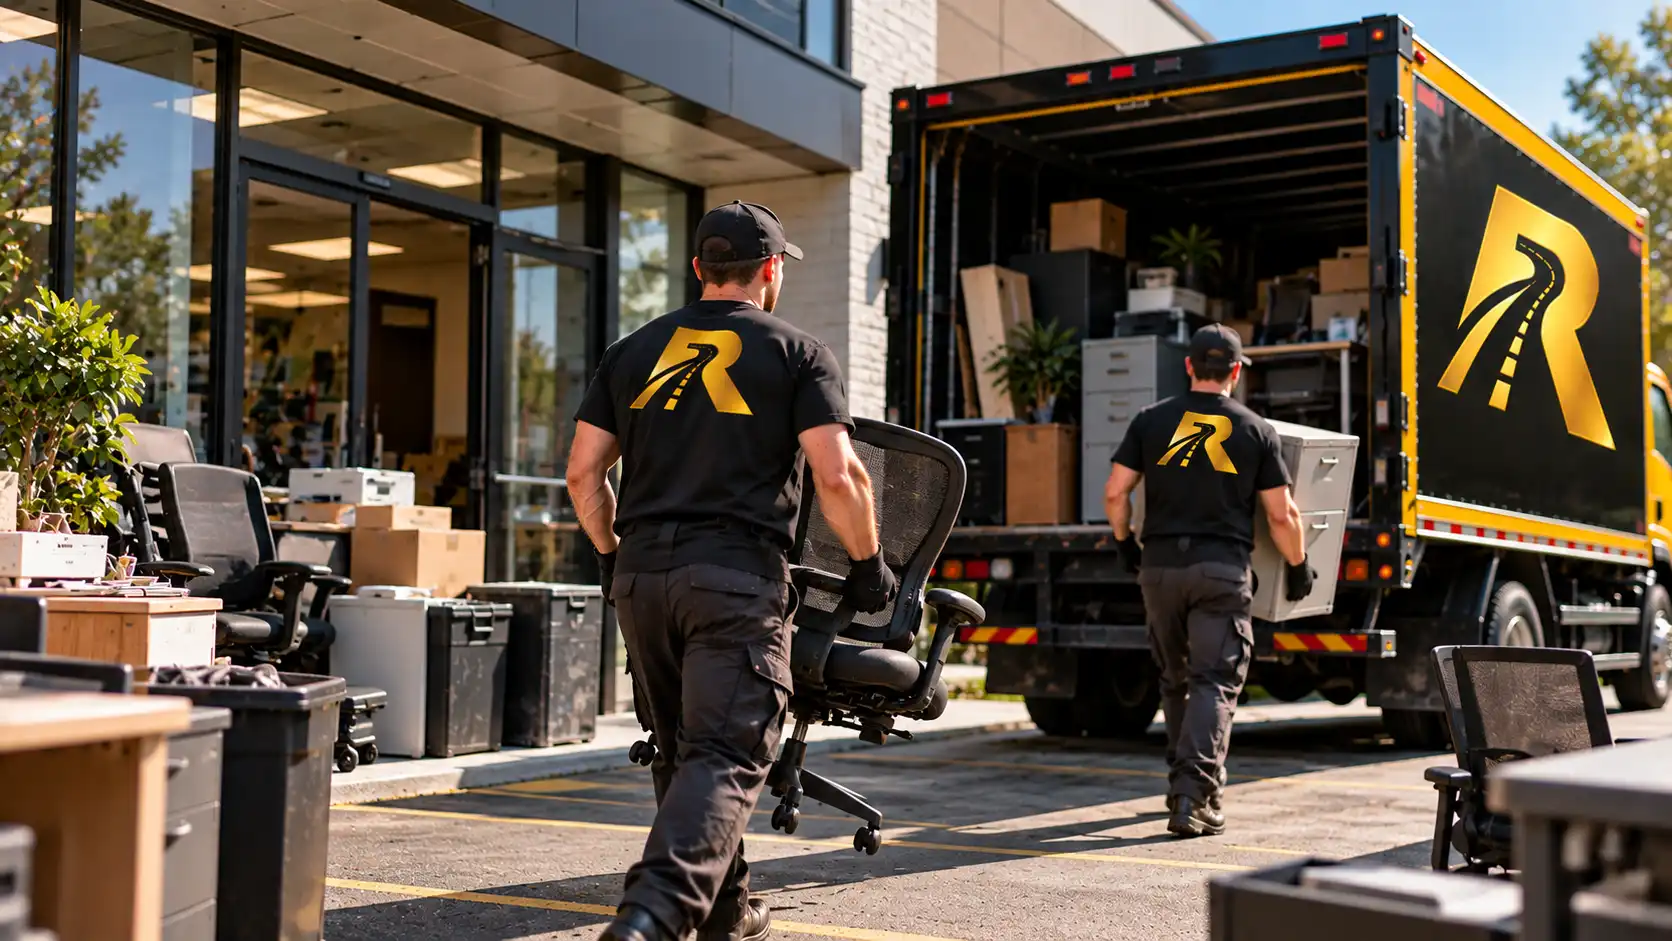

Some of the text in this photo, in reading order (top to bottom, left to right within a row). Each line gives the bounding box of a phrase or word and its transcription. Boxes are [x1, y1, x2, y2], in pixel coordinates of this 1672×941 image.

[1437, 184, 1616, 451] R
[629, 326, 754, 416] R
[1156, 410, 1238, 475] R
